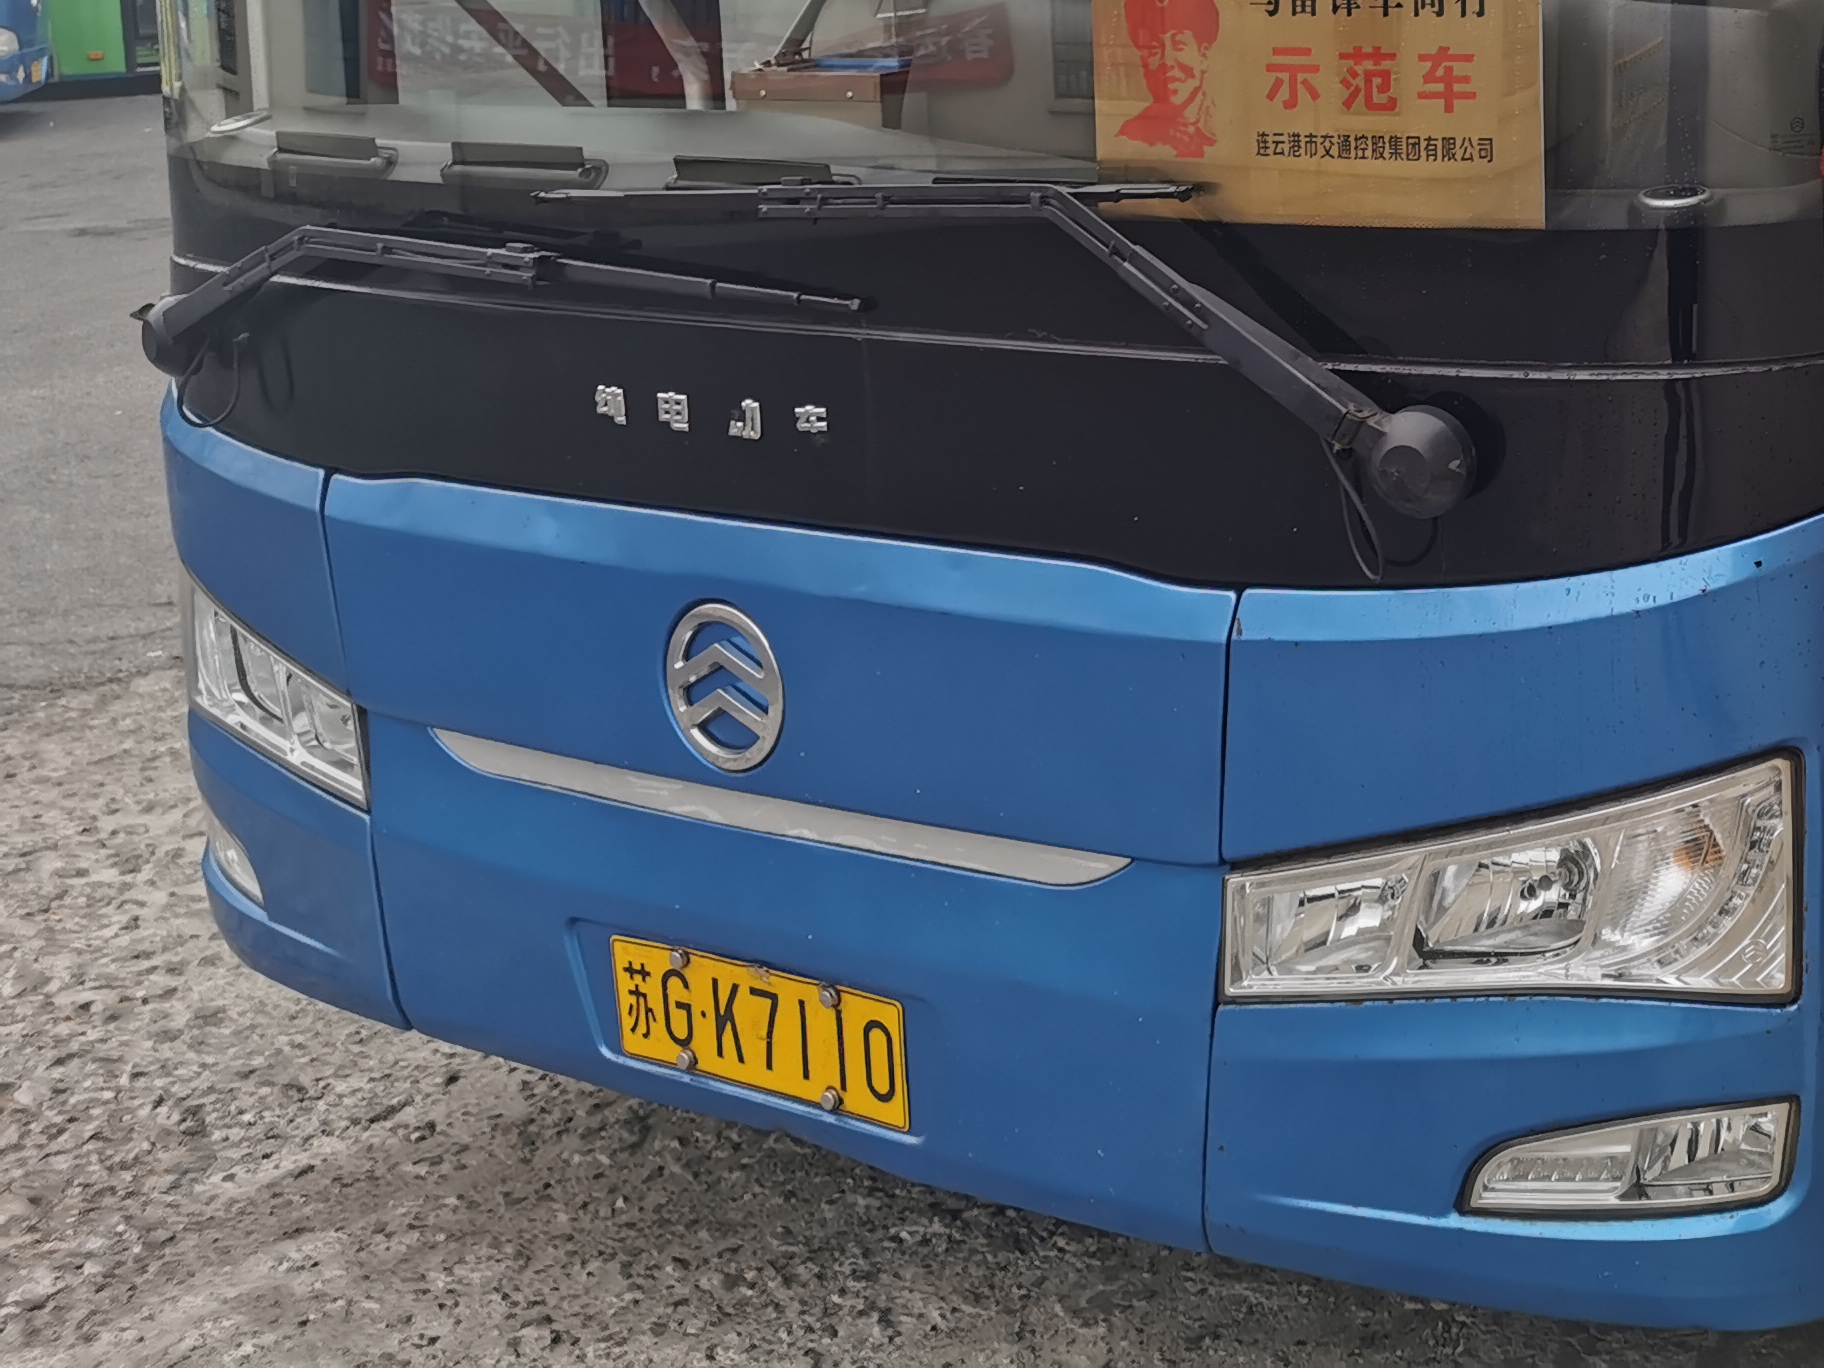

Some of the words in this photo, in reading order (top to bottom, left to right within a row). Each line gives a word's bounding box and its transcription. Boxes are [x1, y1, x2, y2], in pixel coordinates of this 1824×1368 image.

[1264, 45, 1478, 114] 示范车
[1255, 130, 1495, 164] 连云港市交通控股集团有限公司
